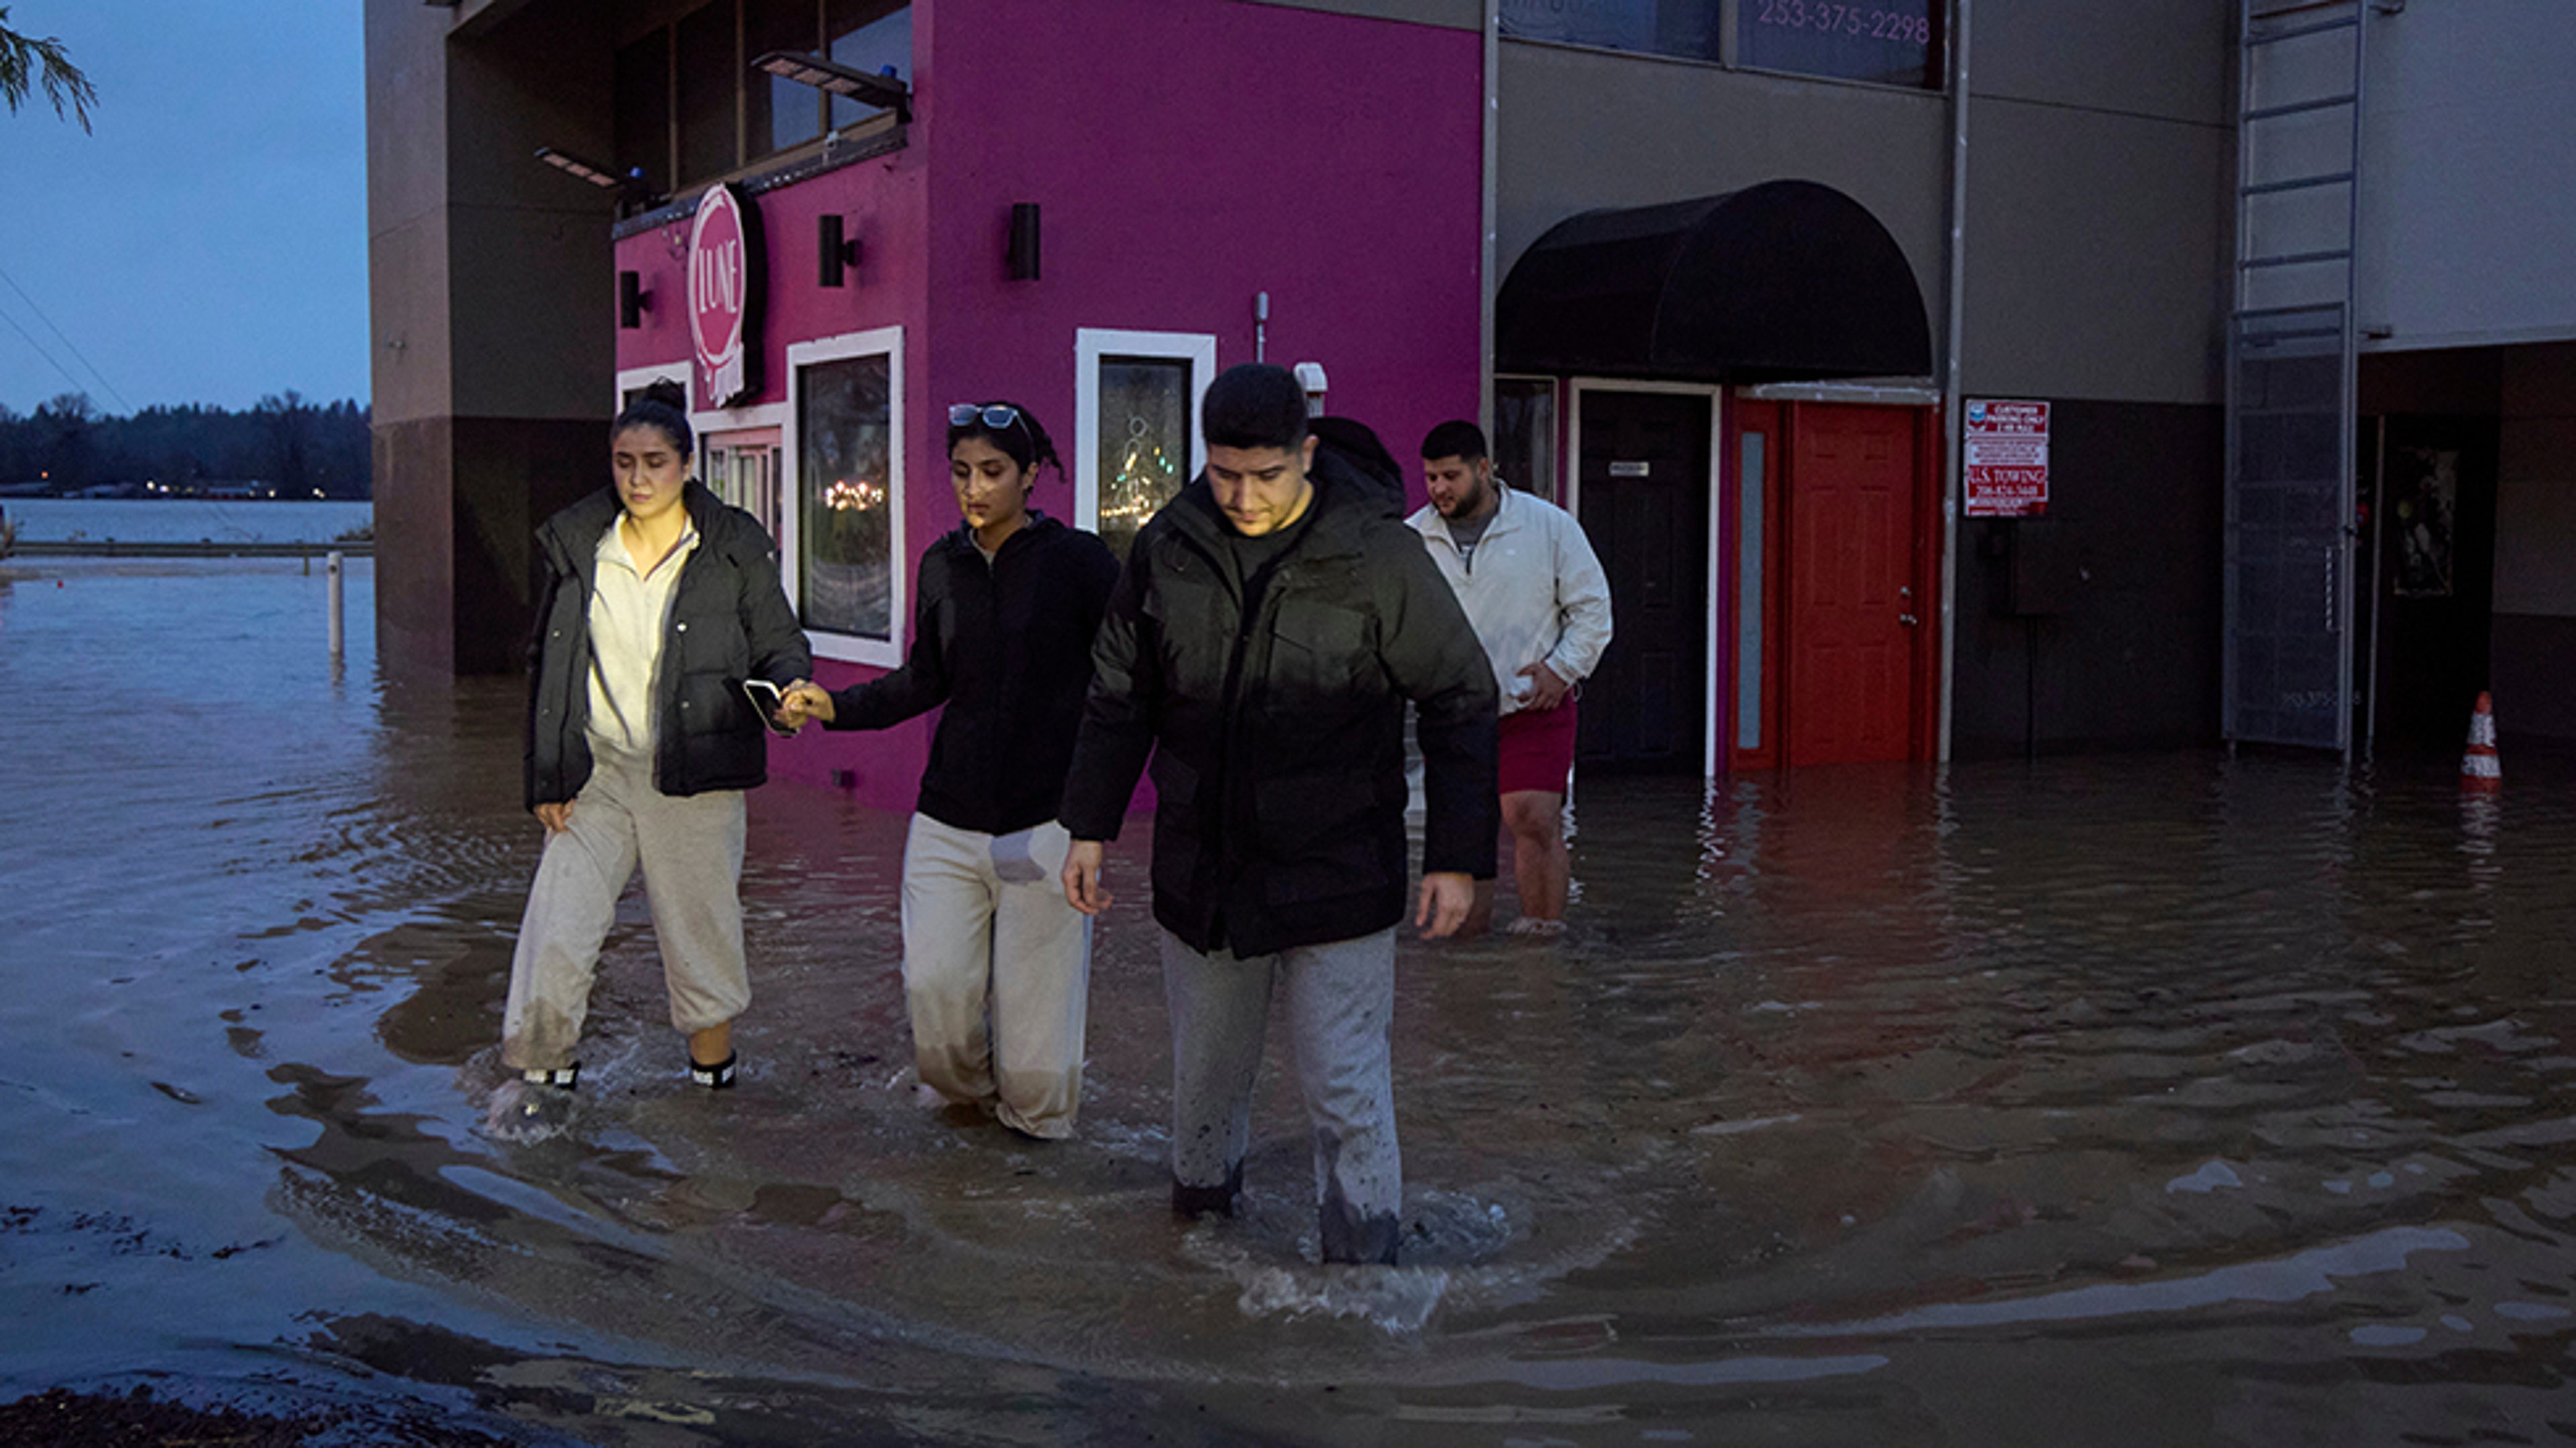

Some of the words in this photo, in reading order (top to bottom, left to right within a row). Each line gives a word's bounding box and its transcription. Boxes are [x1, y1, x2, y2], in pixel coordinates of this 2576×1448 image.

[1758, 0, 1930, 45] 253-375-2298
[698, 239, 737, 314] LUNE
[1993, 469, 2045, 484] TOWING
